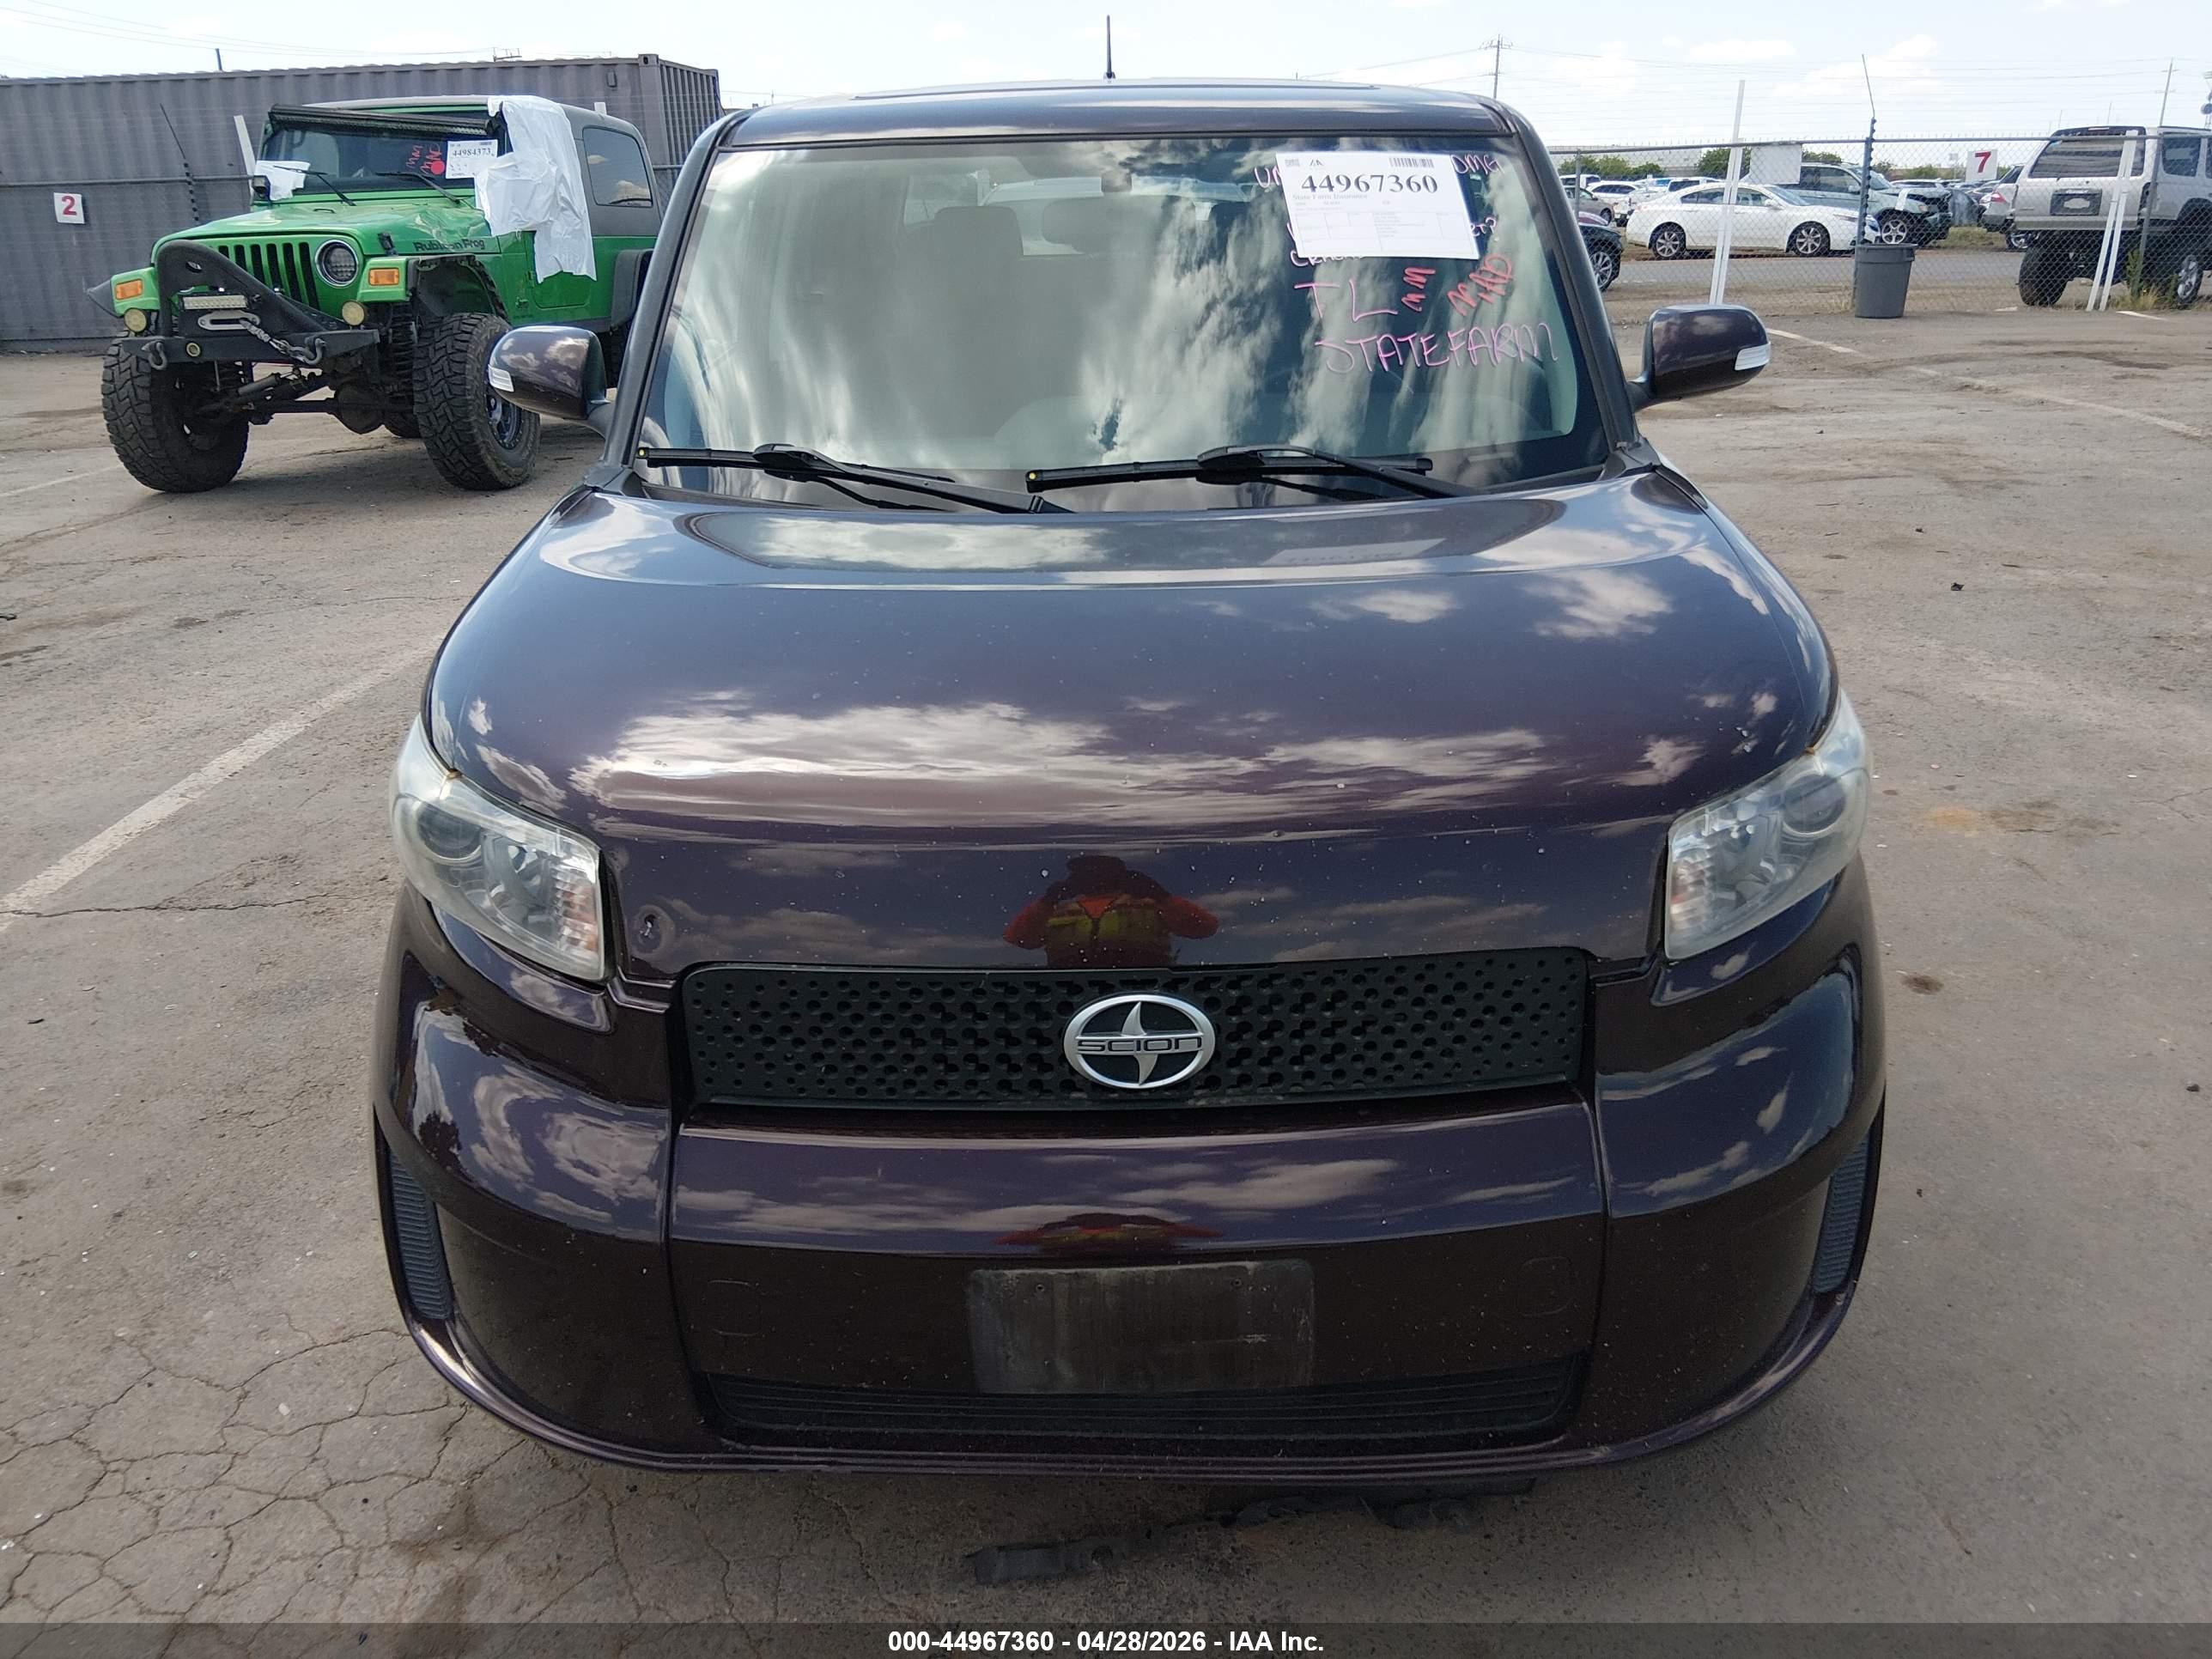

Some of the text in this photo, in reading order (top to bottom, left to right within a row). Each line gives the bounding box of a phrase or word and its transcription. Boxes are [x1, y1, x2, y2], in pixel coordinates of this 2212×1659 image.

[452, 148, 491, 157] 44984373
[1975, 151, 1991, 173] 7
[1301, 174, 1438, 194] 44967360
[61, 195, 77, 216] 2
[461, 239, 485, 250] Frog
